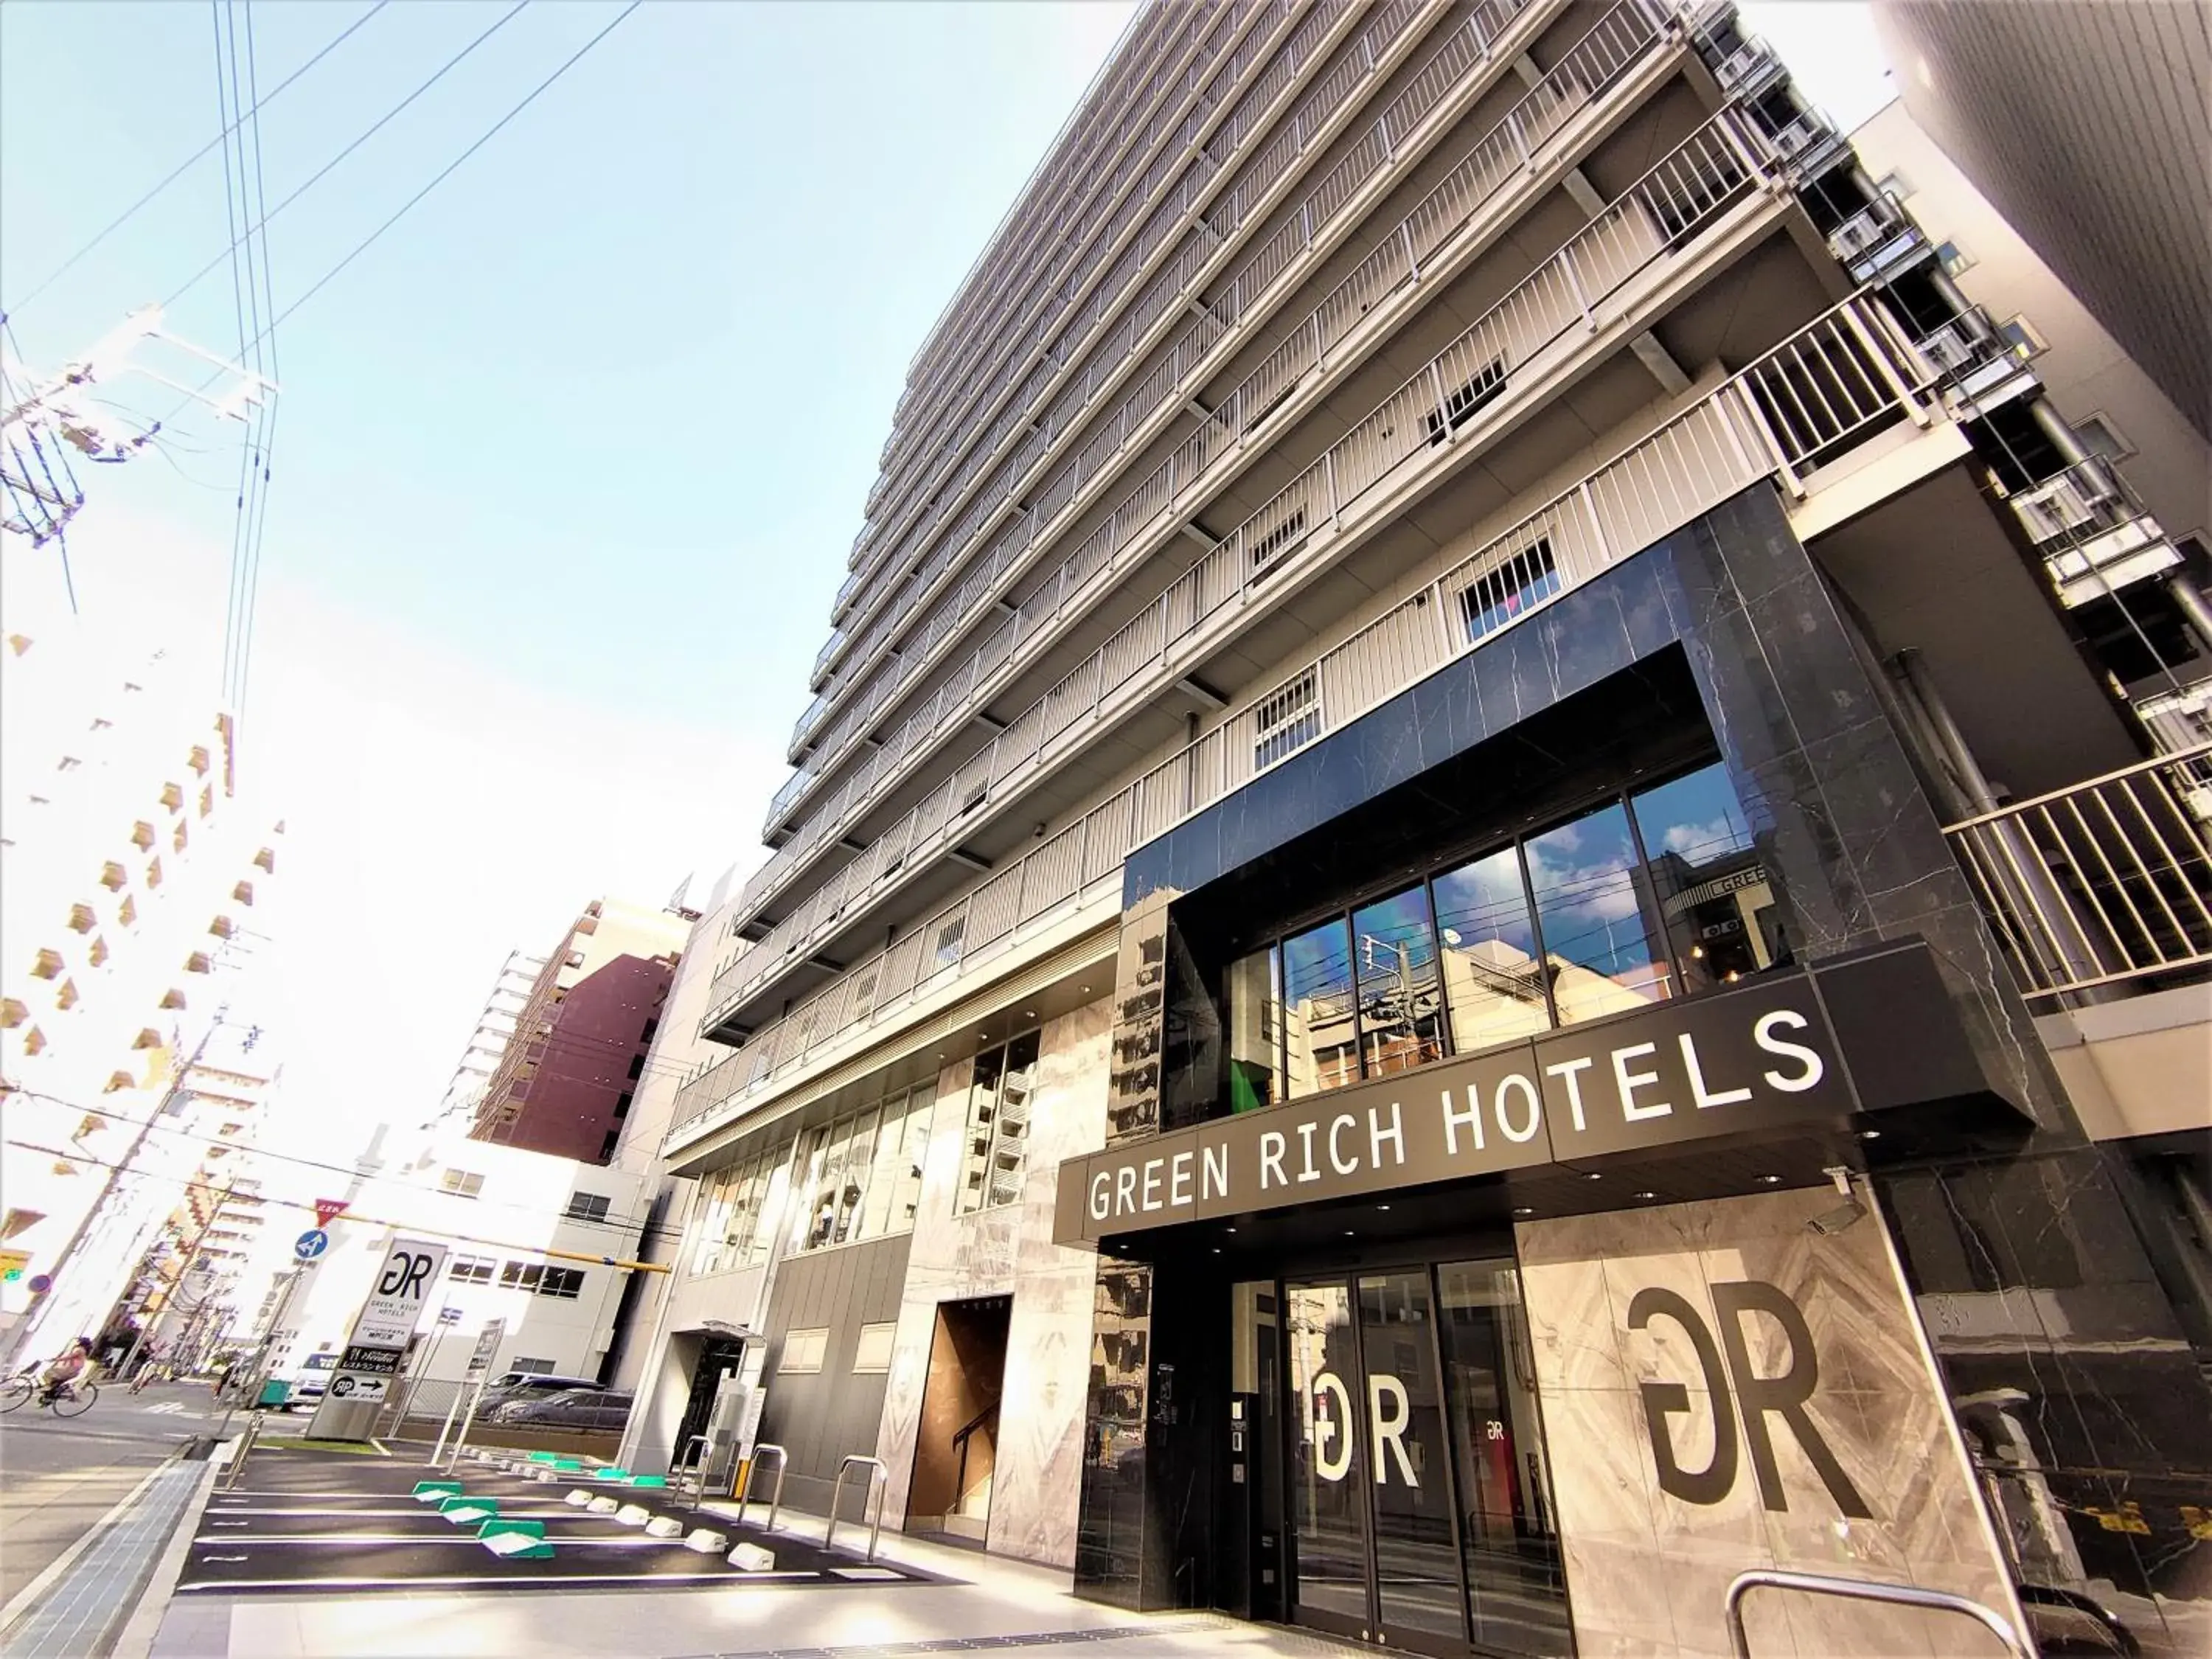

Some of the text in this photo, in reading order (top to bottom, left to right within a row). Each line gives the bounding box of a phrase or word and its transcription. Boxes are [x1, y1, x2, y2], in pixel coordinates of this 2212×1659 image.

[1090, 1010, 1824, 1220] GREEN RICH HOTELS
